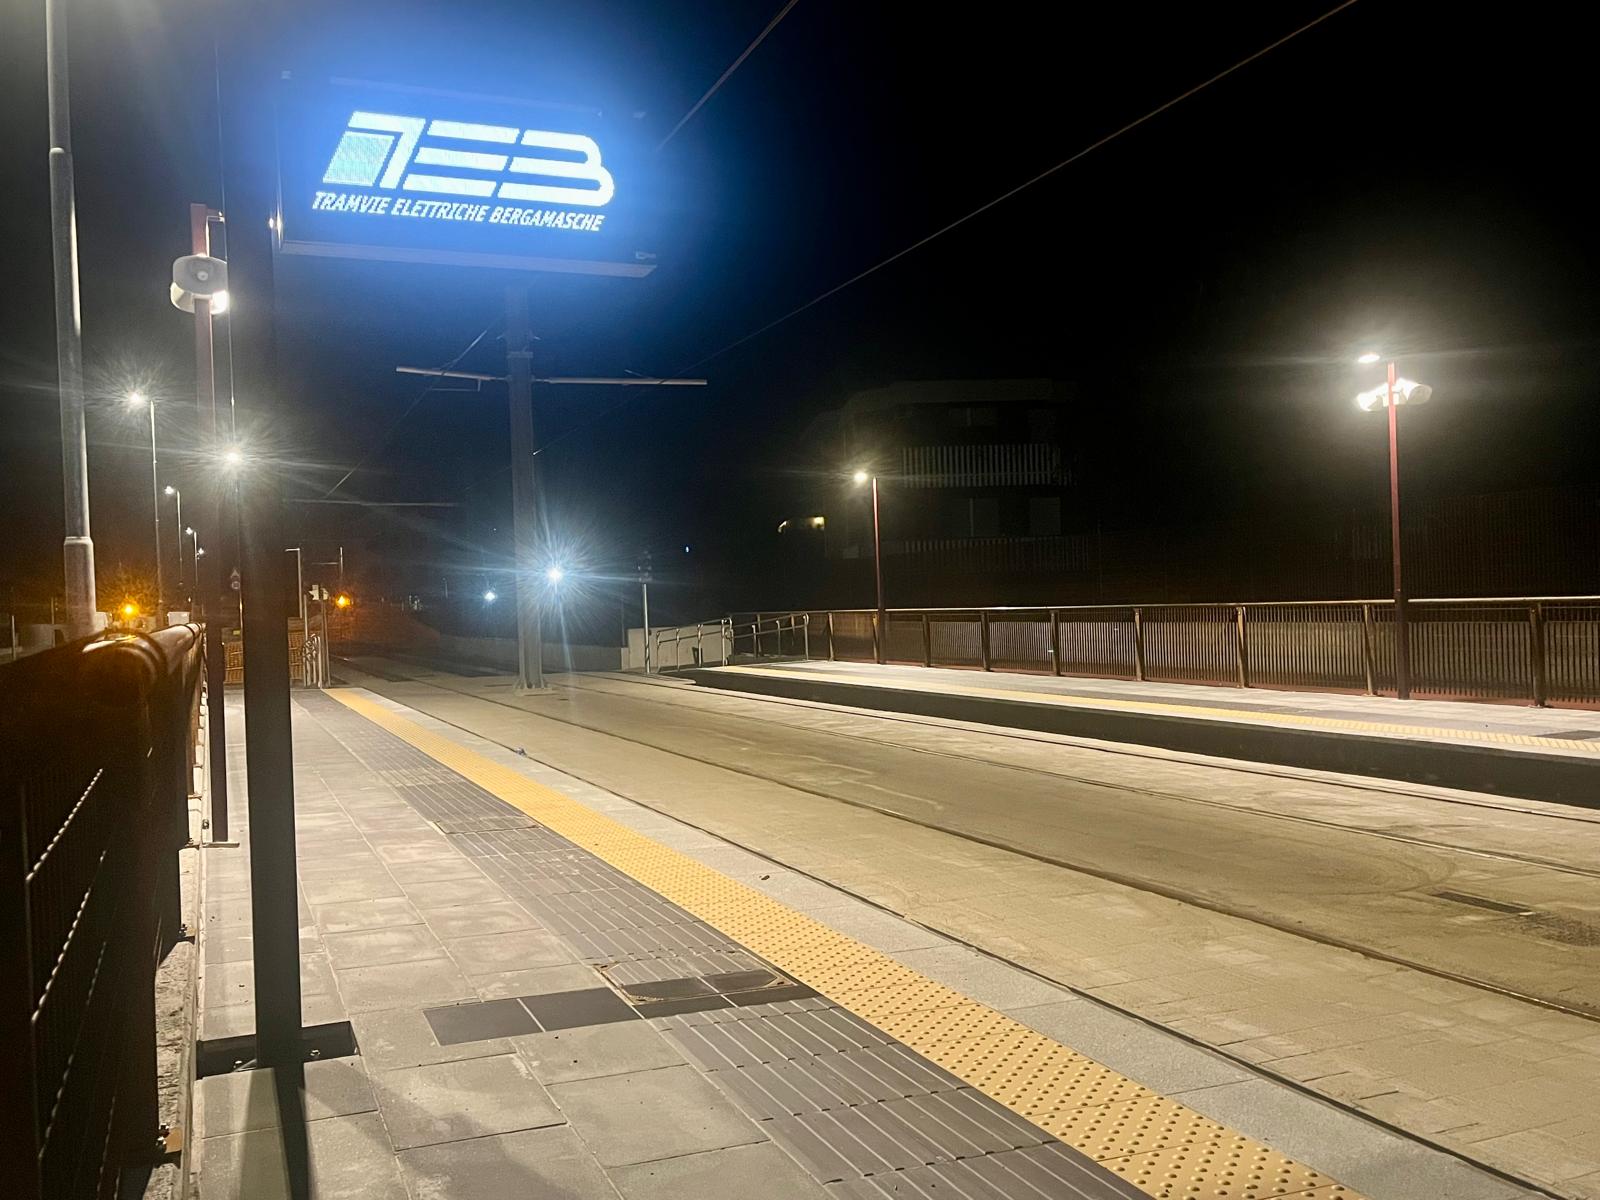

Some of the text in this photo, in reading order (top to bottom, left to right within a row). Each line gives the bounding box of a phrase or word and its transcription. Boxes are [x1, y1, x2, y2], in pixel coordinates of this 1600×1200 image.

[312, 191, 605, 231] TRAMVIE ELETTRICHE BERGAMASCHE
